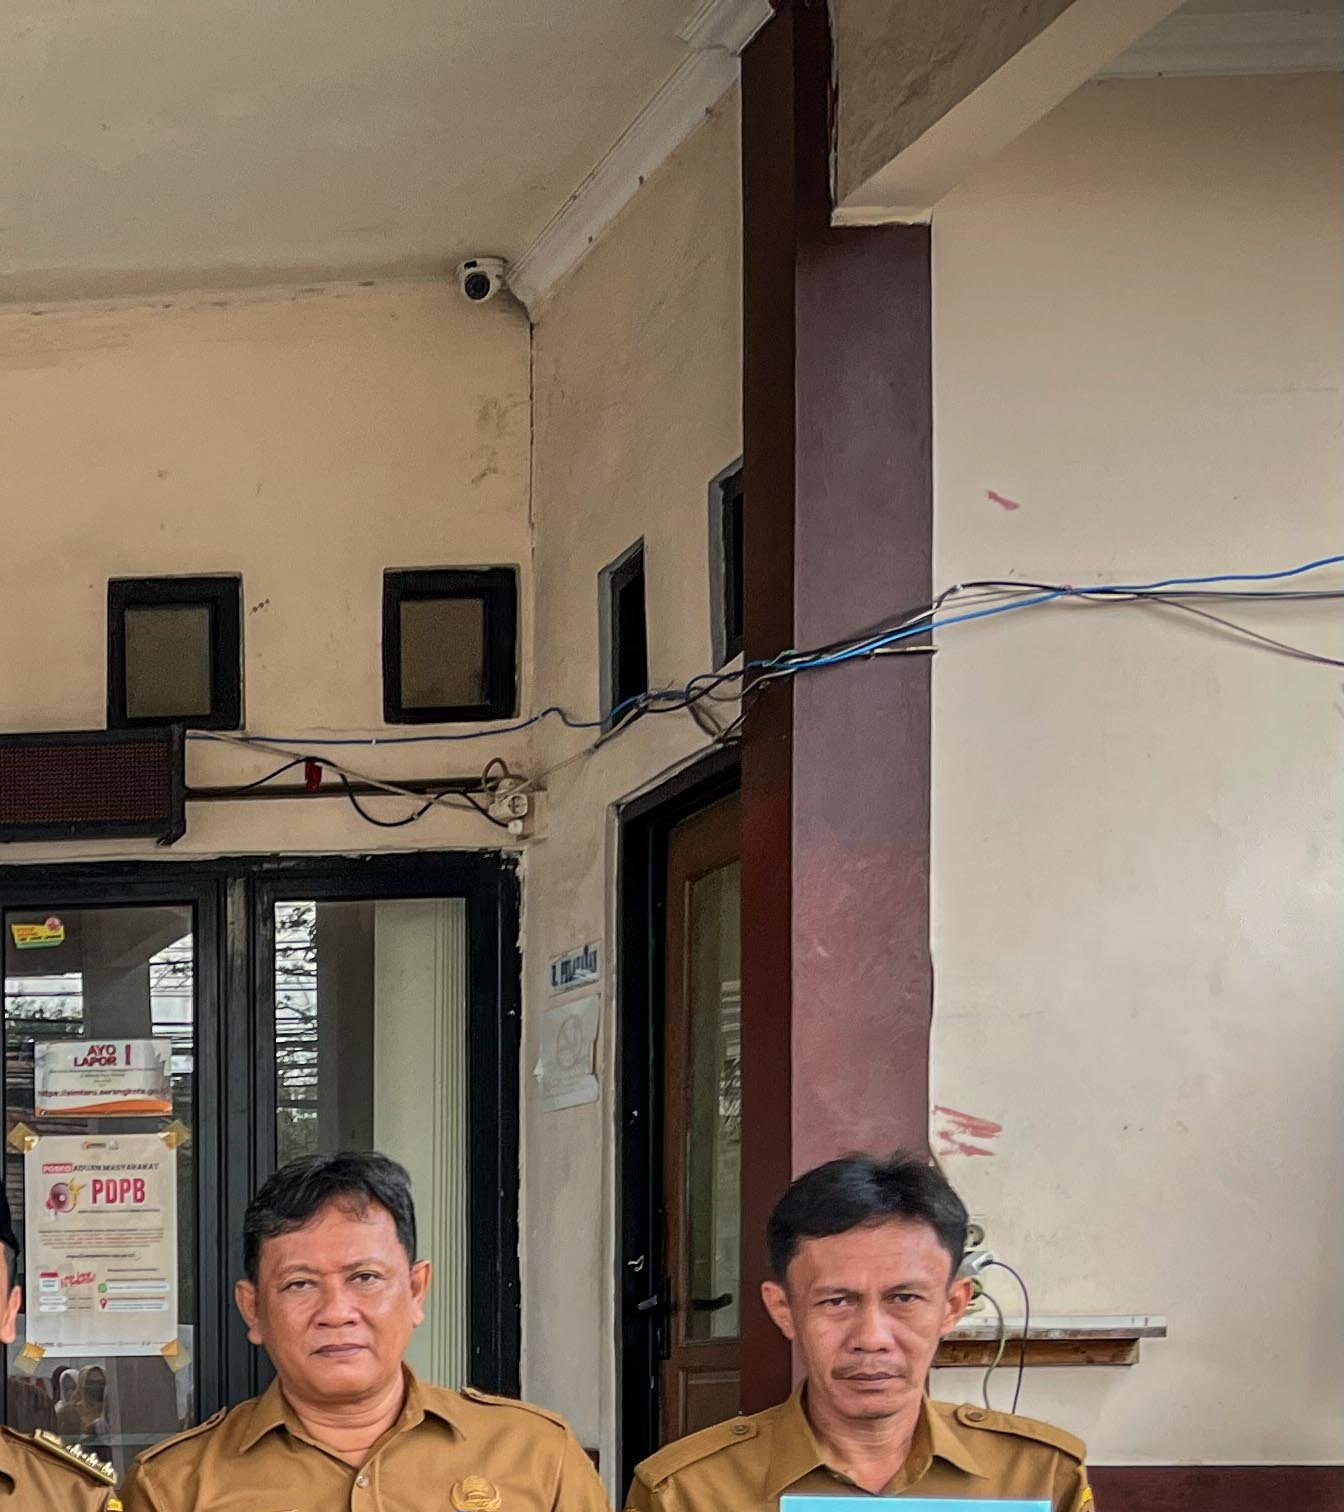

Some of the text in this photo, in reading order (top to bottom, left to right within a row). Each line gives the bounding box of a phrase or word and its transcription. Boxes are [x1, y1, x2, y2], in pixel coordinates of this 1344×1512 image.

[87, 1045, 116, 1056] AYO
[74, 1057, 117, 1067] LAPOR
[103, 1163, 159, 1171] MASYARAKAT
[92, 1179, 145, 1204] PDPB
